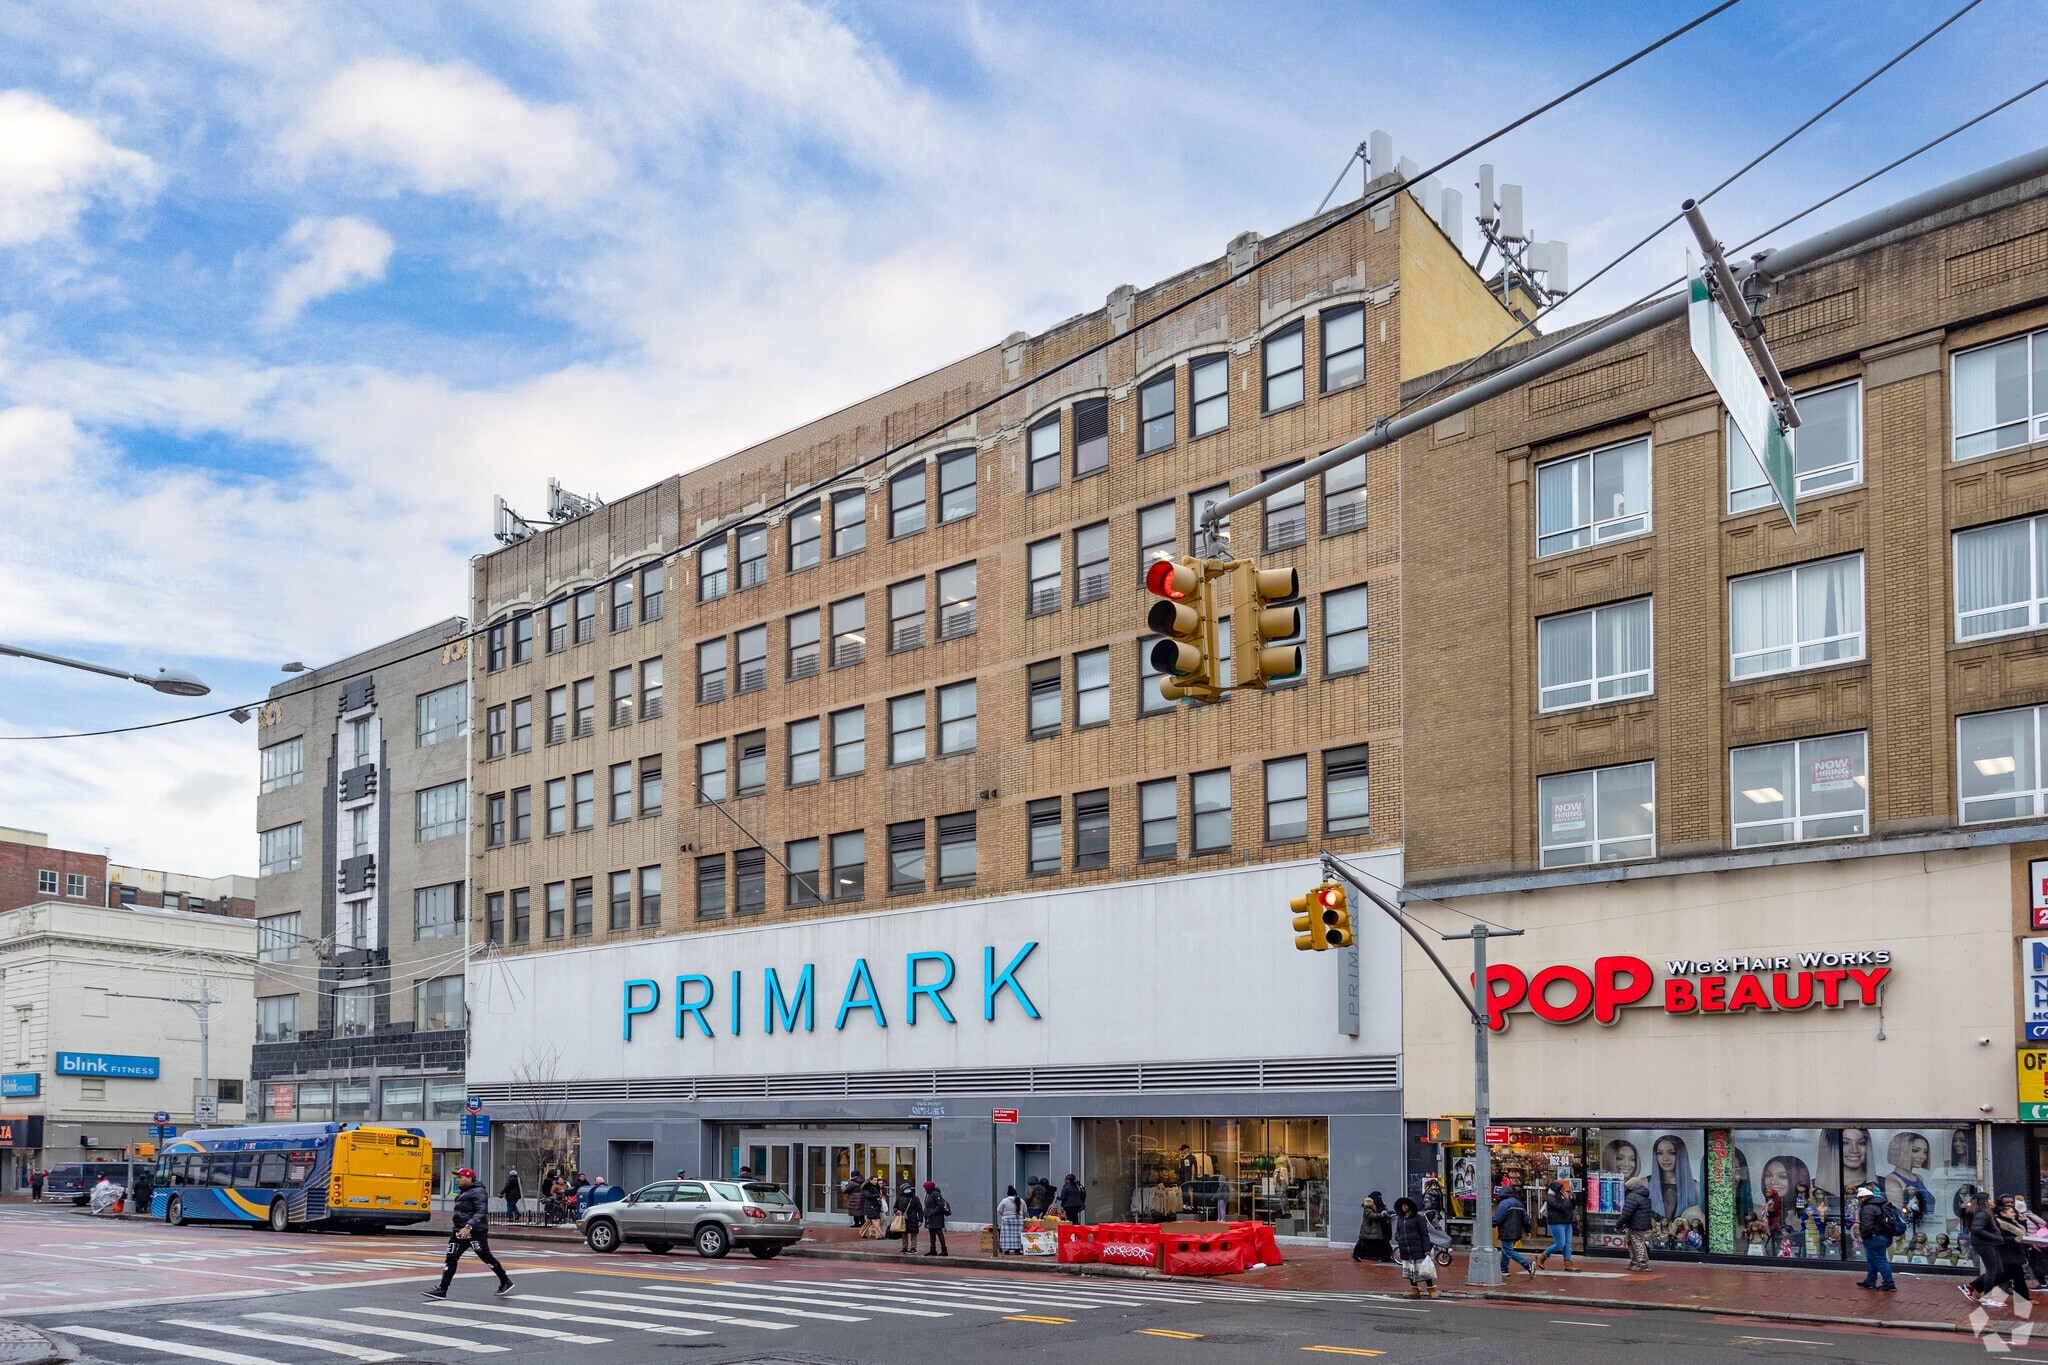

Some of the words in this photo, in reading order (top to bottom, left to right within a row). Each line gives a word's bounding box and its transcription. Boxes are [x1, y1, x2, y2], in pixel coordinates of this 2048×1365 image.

[1815, 758, 1849, 771] NOW
[1815, 767, 1849, 778] HIRING
[1554, 802, 1582, 813] NOW
[1554, 810, 1583, 819] HIRING
[1797, 950, 1891, 968] WORKS
[623, 941, 1042, 1041] PRIMARK
[1470, 955, 1655, 1032] POP
[1664, 967, 1892, 1013] BEAUTY
[63, 1055, 108, 1072] blink
[110, 1066, 154, 1075] FITNESS
[0, 1126, 12, 1138] TA
[1509, 1132, 1532, 1145] OP
[1534, 1135, 1575, 1145] BEAUTY
[406, 1150, 422, 1158] 7860
